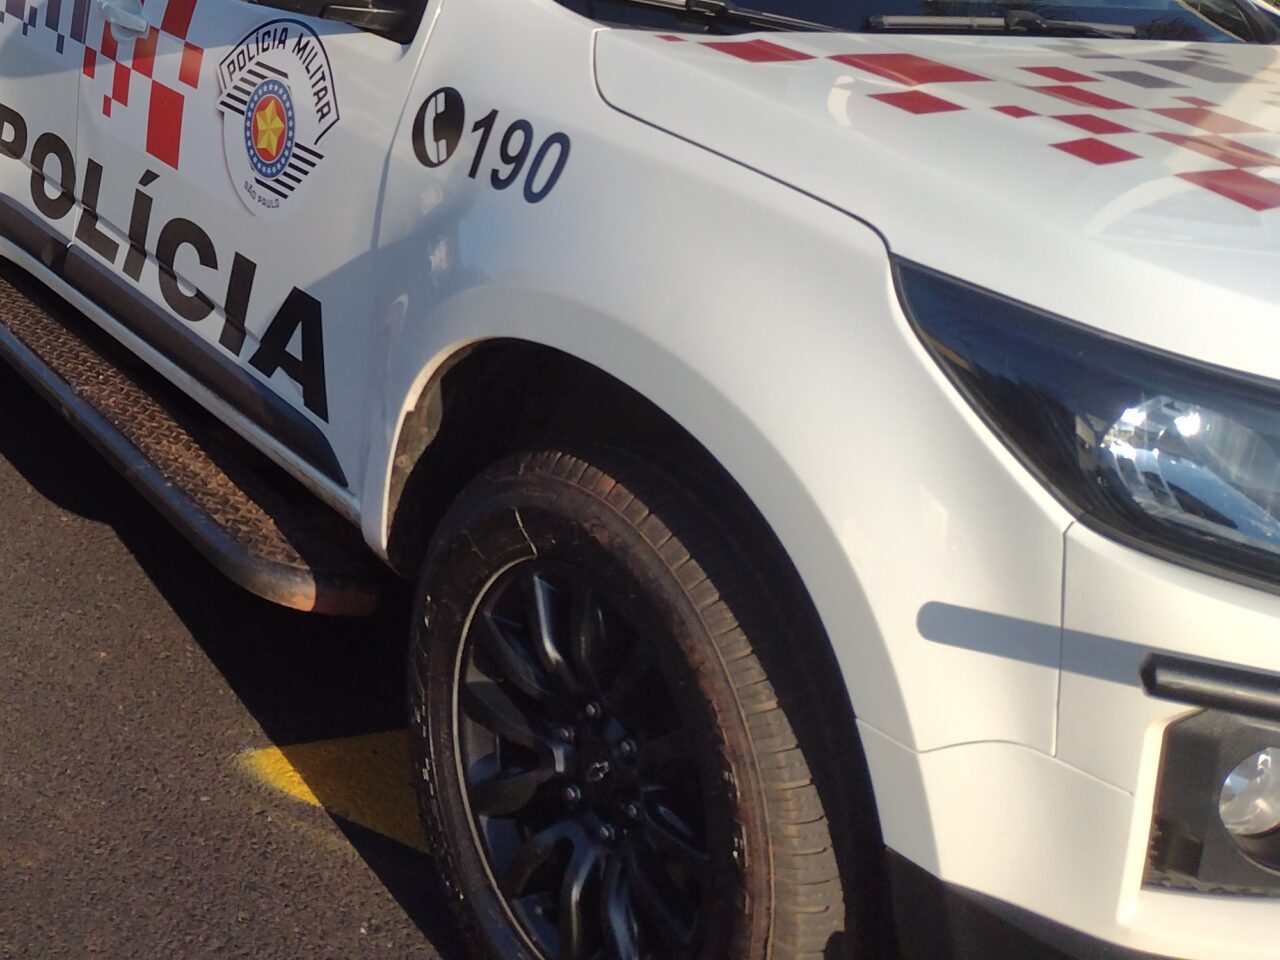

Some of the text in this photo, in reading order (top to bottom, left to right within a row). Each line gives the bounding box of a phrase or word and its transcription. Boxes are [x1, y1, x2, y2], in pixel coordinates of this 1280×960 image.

[227, 27, 332, 124] POLÍCIA MILITAR
[257, 196, 280, 209] PAULO
[468, 108, 571, 204] 190
